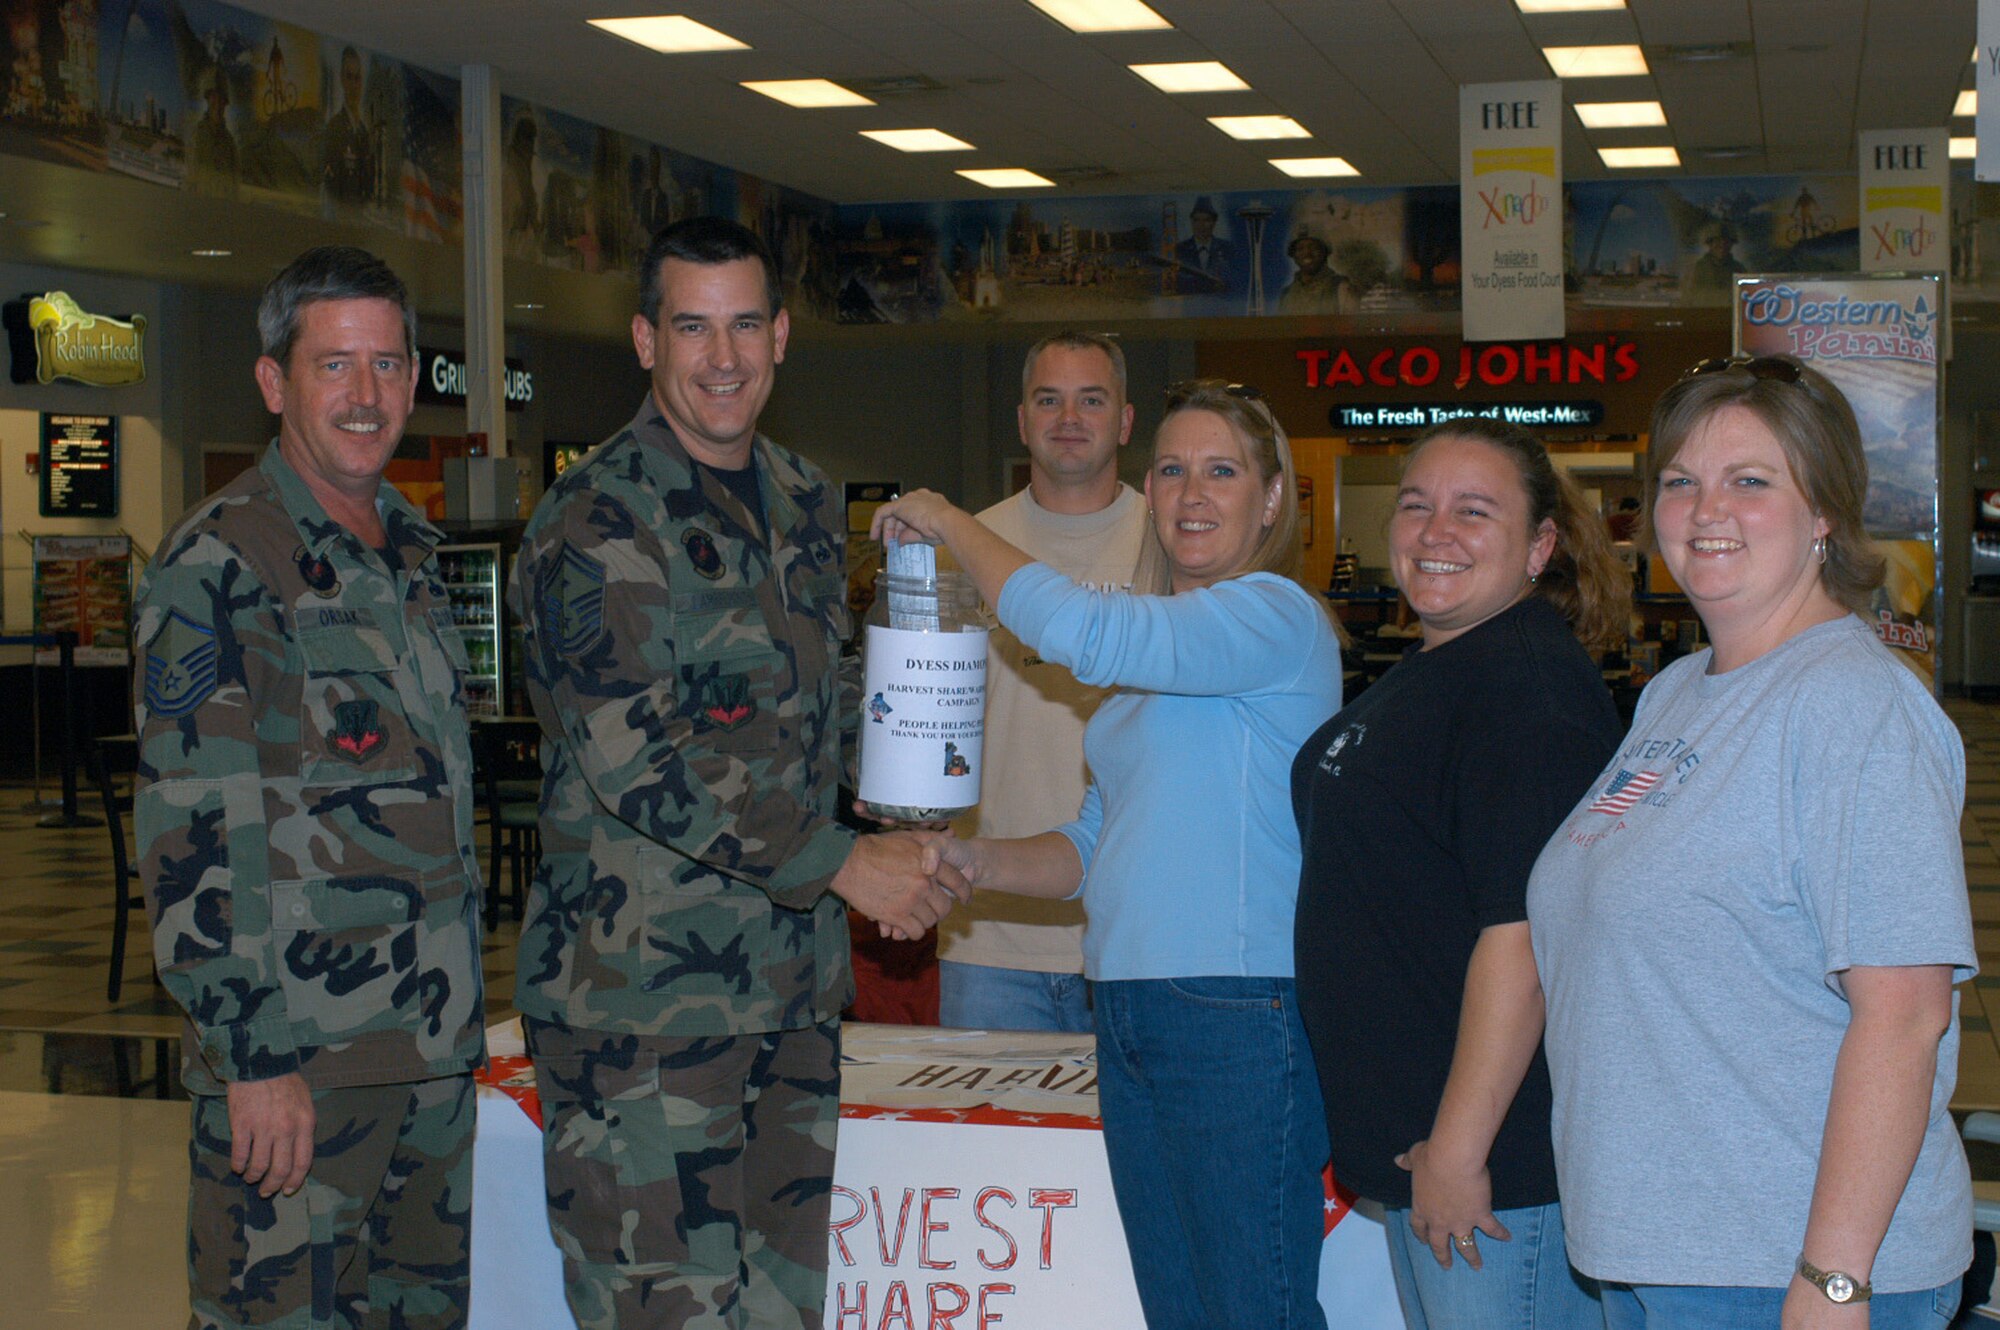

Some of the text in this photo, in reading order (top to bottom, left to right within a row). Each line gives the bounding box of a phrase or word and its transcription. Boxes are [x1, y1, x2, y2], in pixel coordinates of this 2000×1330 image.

[1482, 102, 1540, 130] FREE
[1876, 144, 1928, 170] FREE
[1494, 250, 1530, 267] Available
[1471, 271, 1560, 292] Your Dyess Food Court
[1741, 284, 1901, 327] Western
[55, 331, 139, 361] Robin Hood
[1296, 336, 1640, 390] TACO JOHN'S
[1341, 408, 1374, 425] The
[1377, 407, 1425, 425] Fresh
[1503, 405, 1591, 424] West-Mex
[906, 659, 950, 671] DYESS
[887, 683, 935, 695] HARVEST
[937, 698, 980, 707] CAMPAIGN
[891, 729, 919, 739] THANK
[921, 731, 940, 740] YOU
[941, 731, 956, 739] FOR
[898, 720, 938, 730] PEOPLE
[941, 720, 977, 730] HELPING
